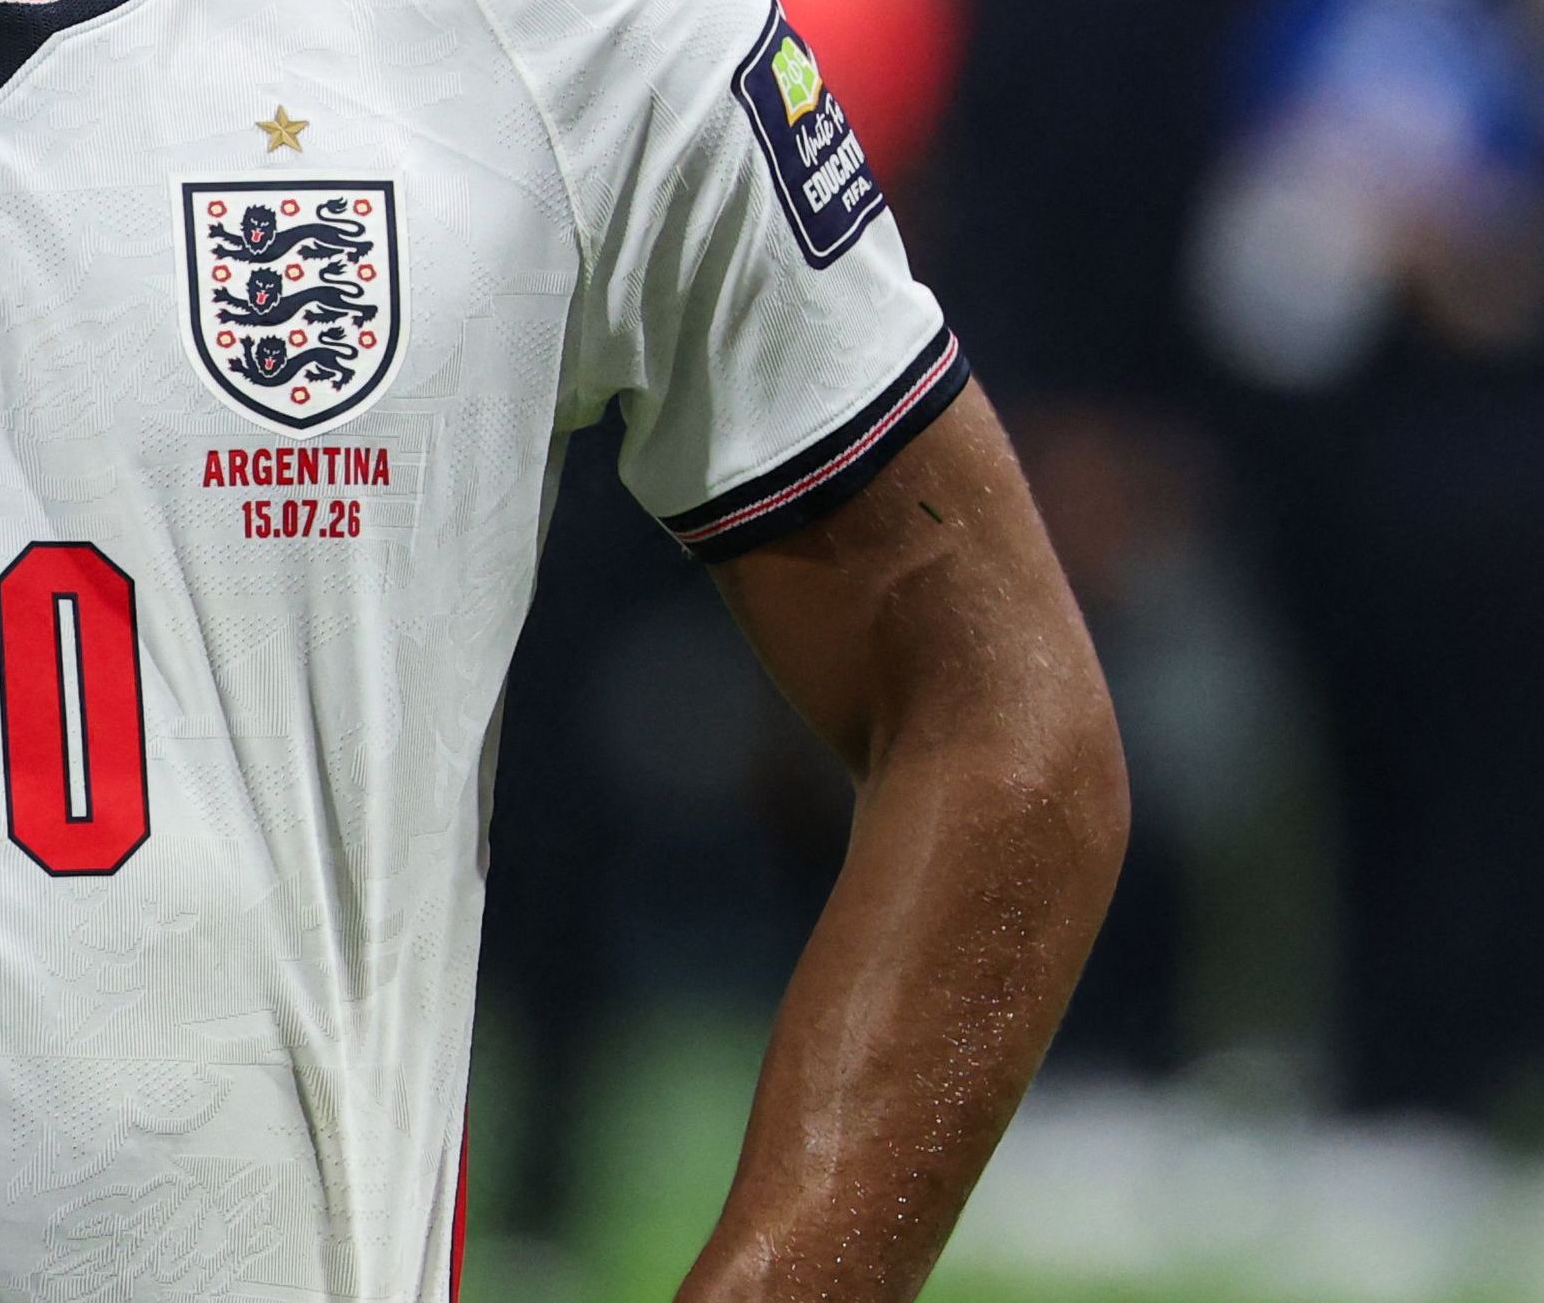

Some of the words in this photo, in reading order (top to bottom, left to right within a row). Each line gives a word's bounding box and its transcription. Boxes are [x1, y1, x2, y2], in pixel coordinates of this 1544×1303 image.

[796, 113, 834, 168] Unite
[825, 92, 845, 134] Fo
[802, 128, 865, 213] EDUCATI
[202, 447, 391, 488] ARGENTINA
[241, 500, 361, 539] 15.07.26
